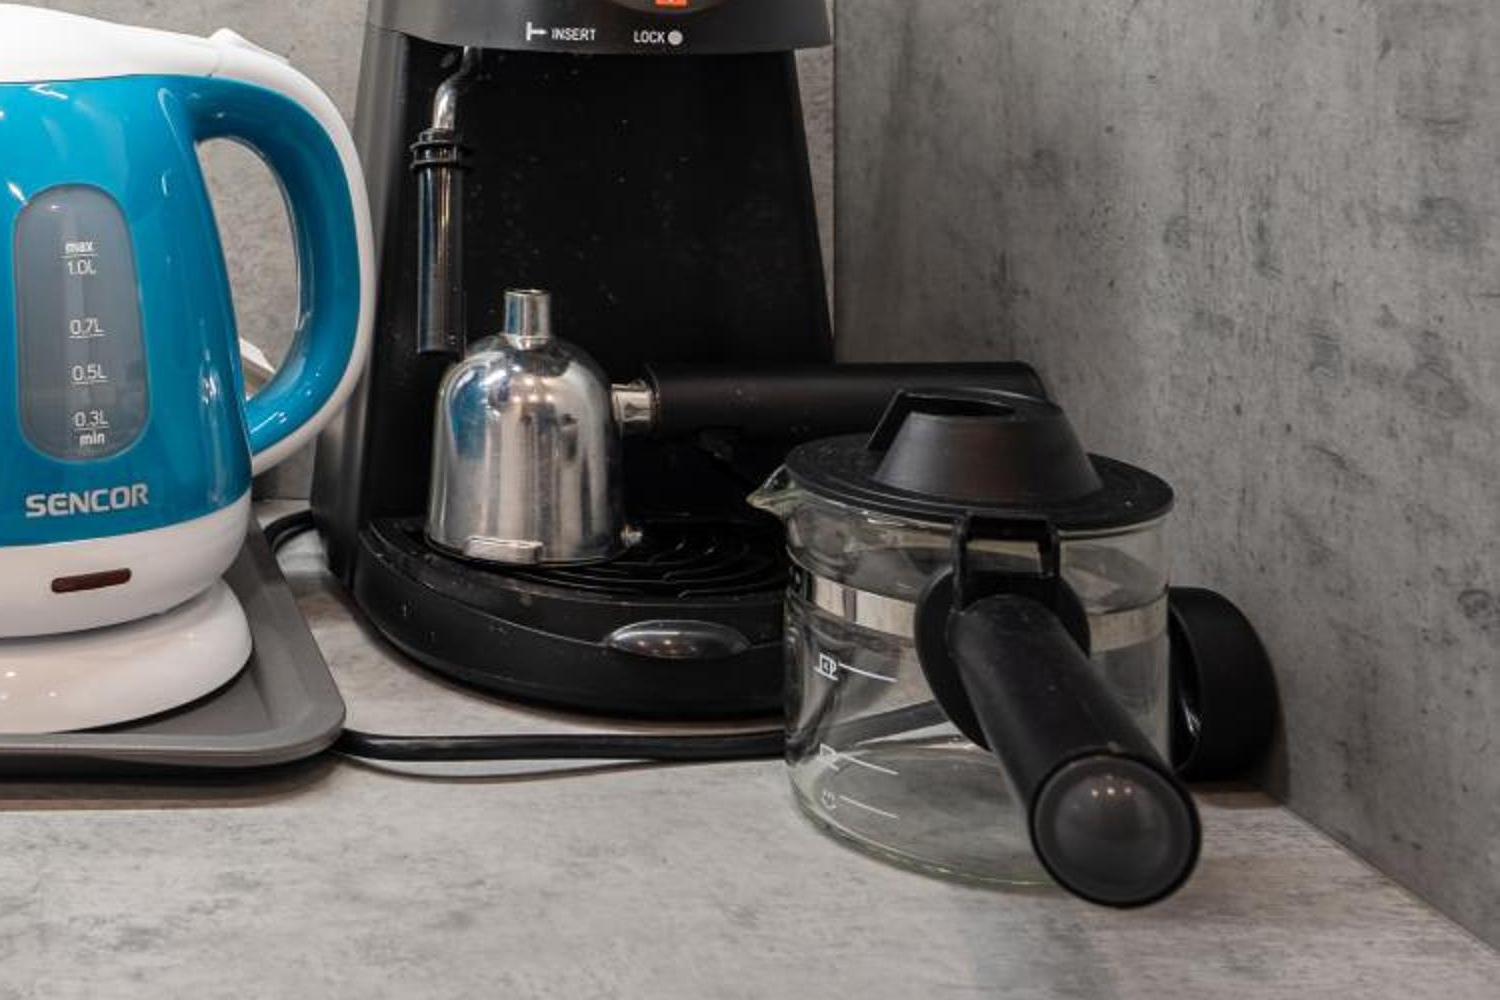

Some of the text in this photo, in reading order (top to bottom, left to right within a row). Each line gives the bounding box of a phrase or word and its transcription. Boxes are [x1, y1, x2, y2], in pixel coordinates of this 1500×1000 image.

[551, 27, 596, 41] INSERT
[633, 30, 665, 43] LOCK
[65, 241, 93, 253] max
[67, 259, 96, 275] 1.0L
[69, 318, 104, 335] 0.7L
[71, 364, 107, 381] 0.5L
[74, 411, 108, 427] 0.3L
[79, 431, 105, 445] min
[25, 483, 149, 518] SENCOR
